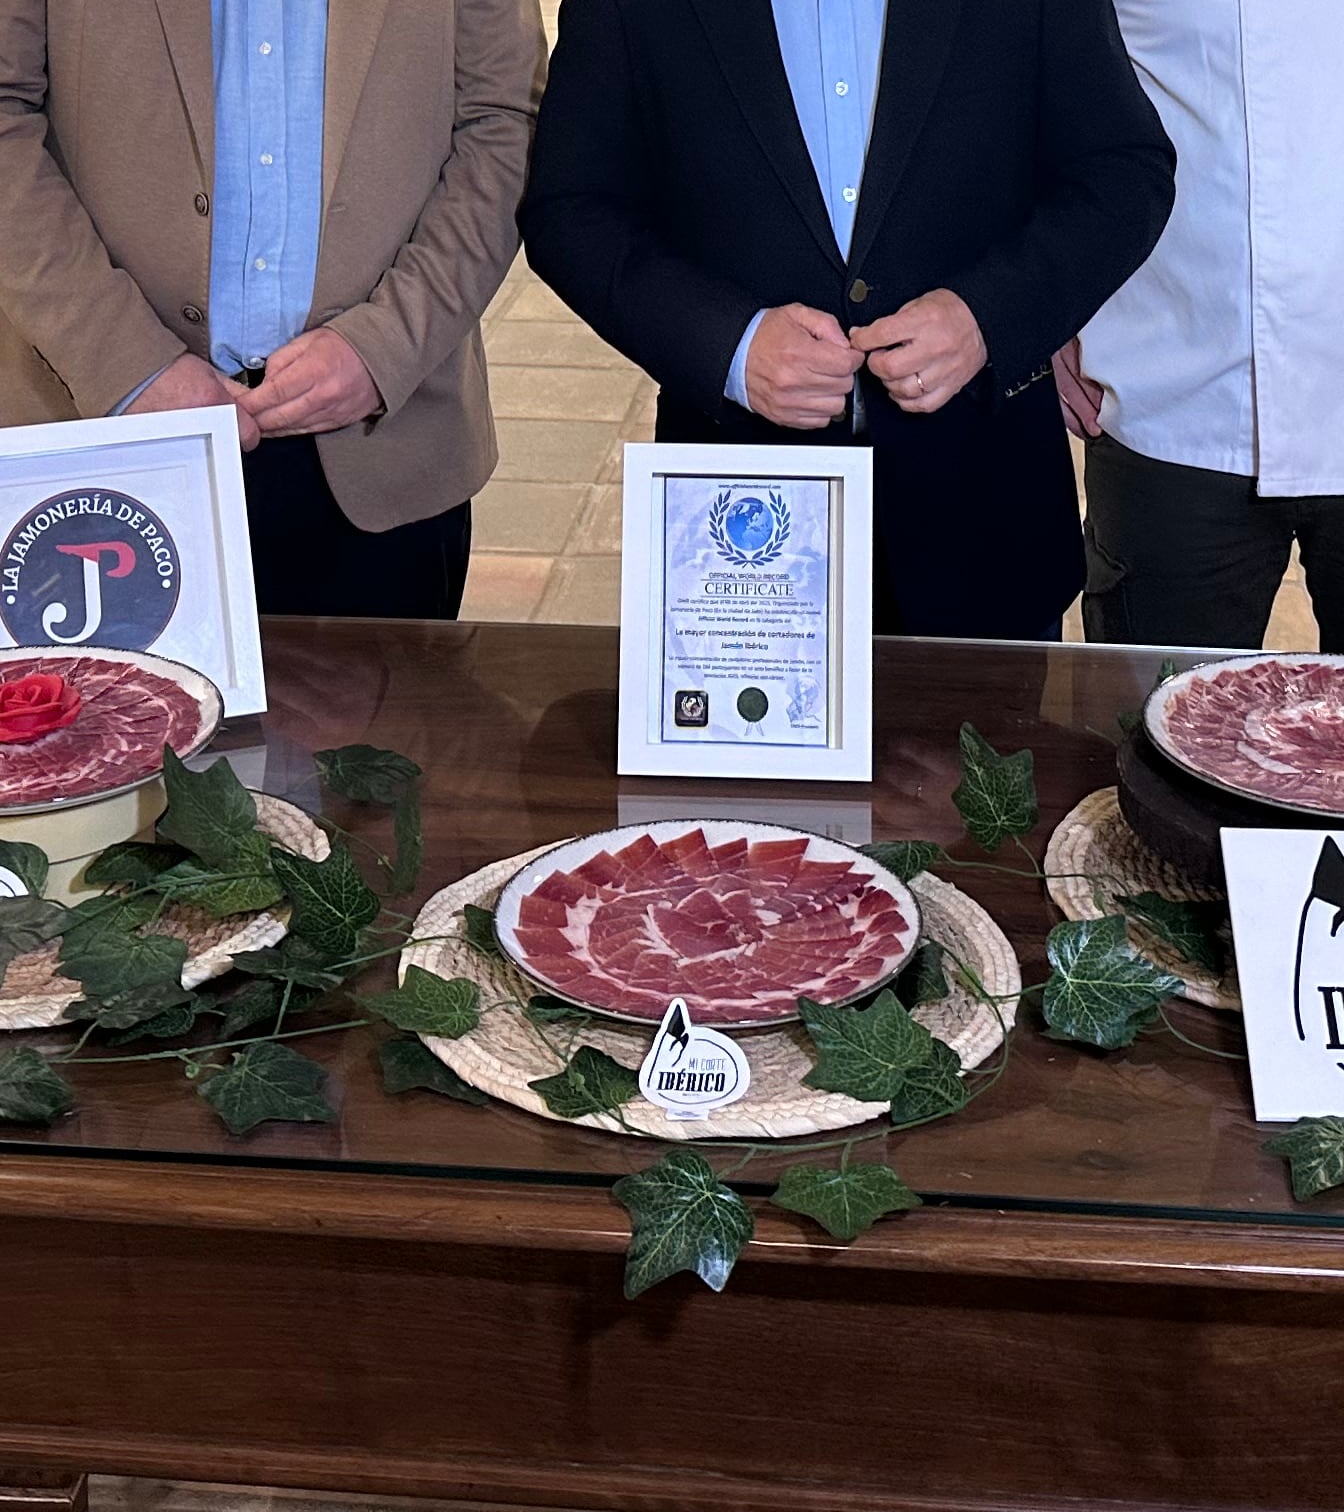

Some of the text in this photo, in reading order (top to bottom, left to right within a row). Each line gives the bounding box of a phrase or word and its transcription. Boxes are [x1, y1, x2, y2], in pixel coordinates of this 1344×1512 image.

[2, 494, 174, 593] LA JAMONERÍA DE PACO
[704, 582, 794, 596] CERTIFICATE
[689, 1058, 698, 1071] MI
[656, 1068, 726, 1092] IBÉRICO
